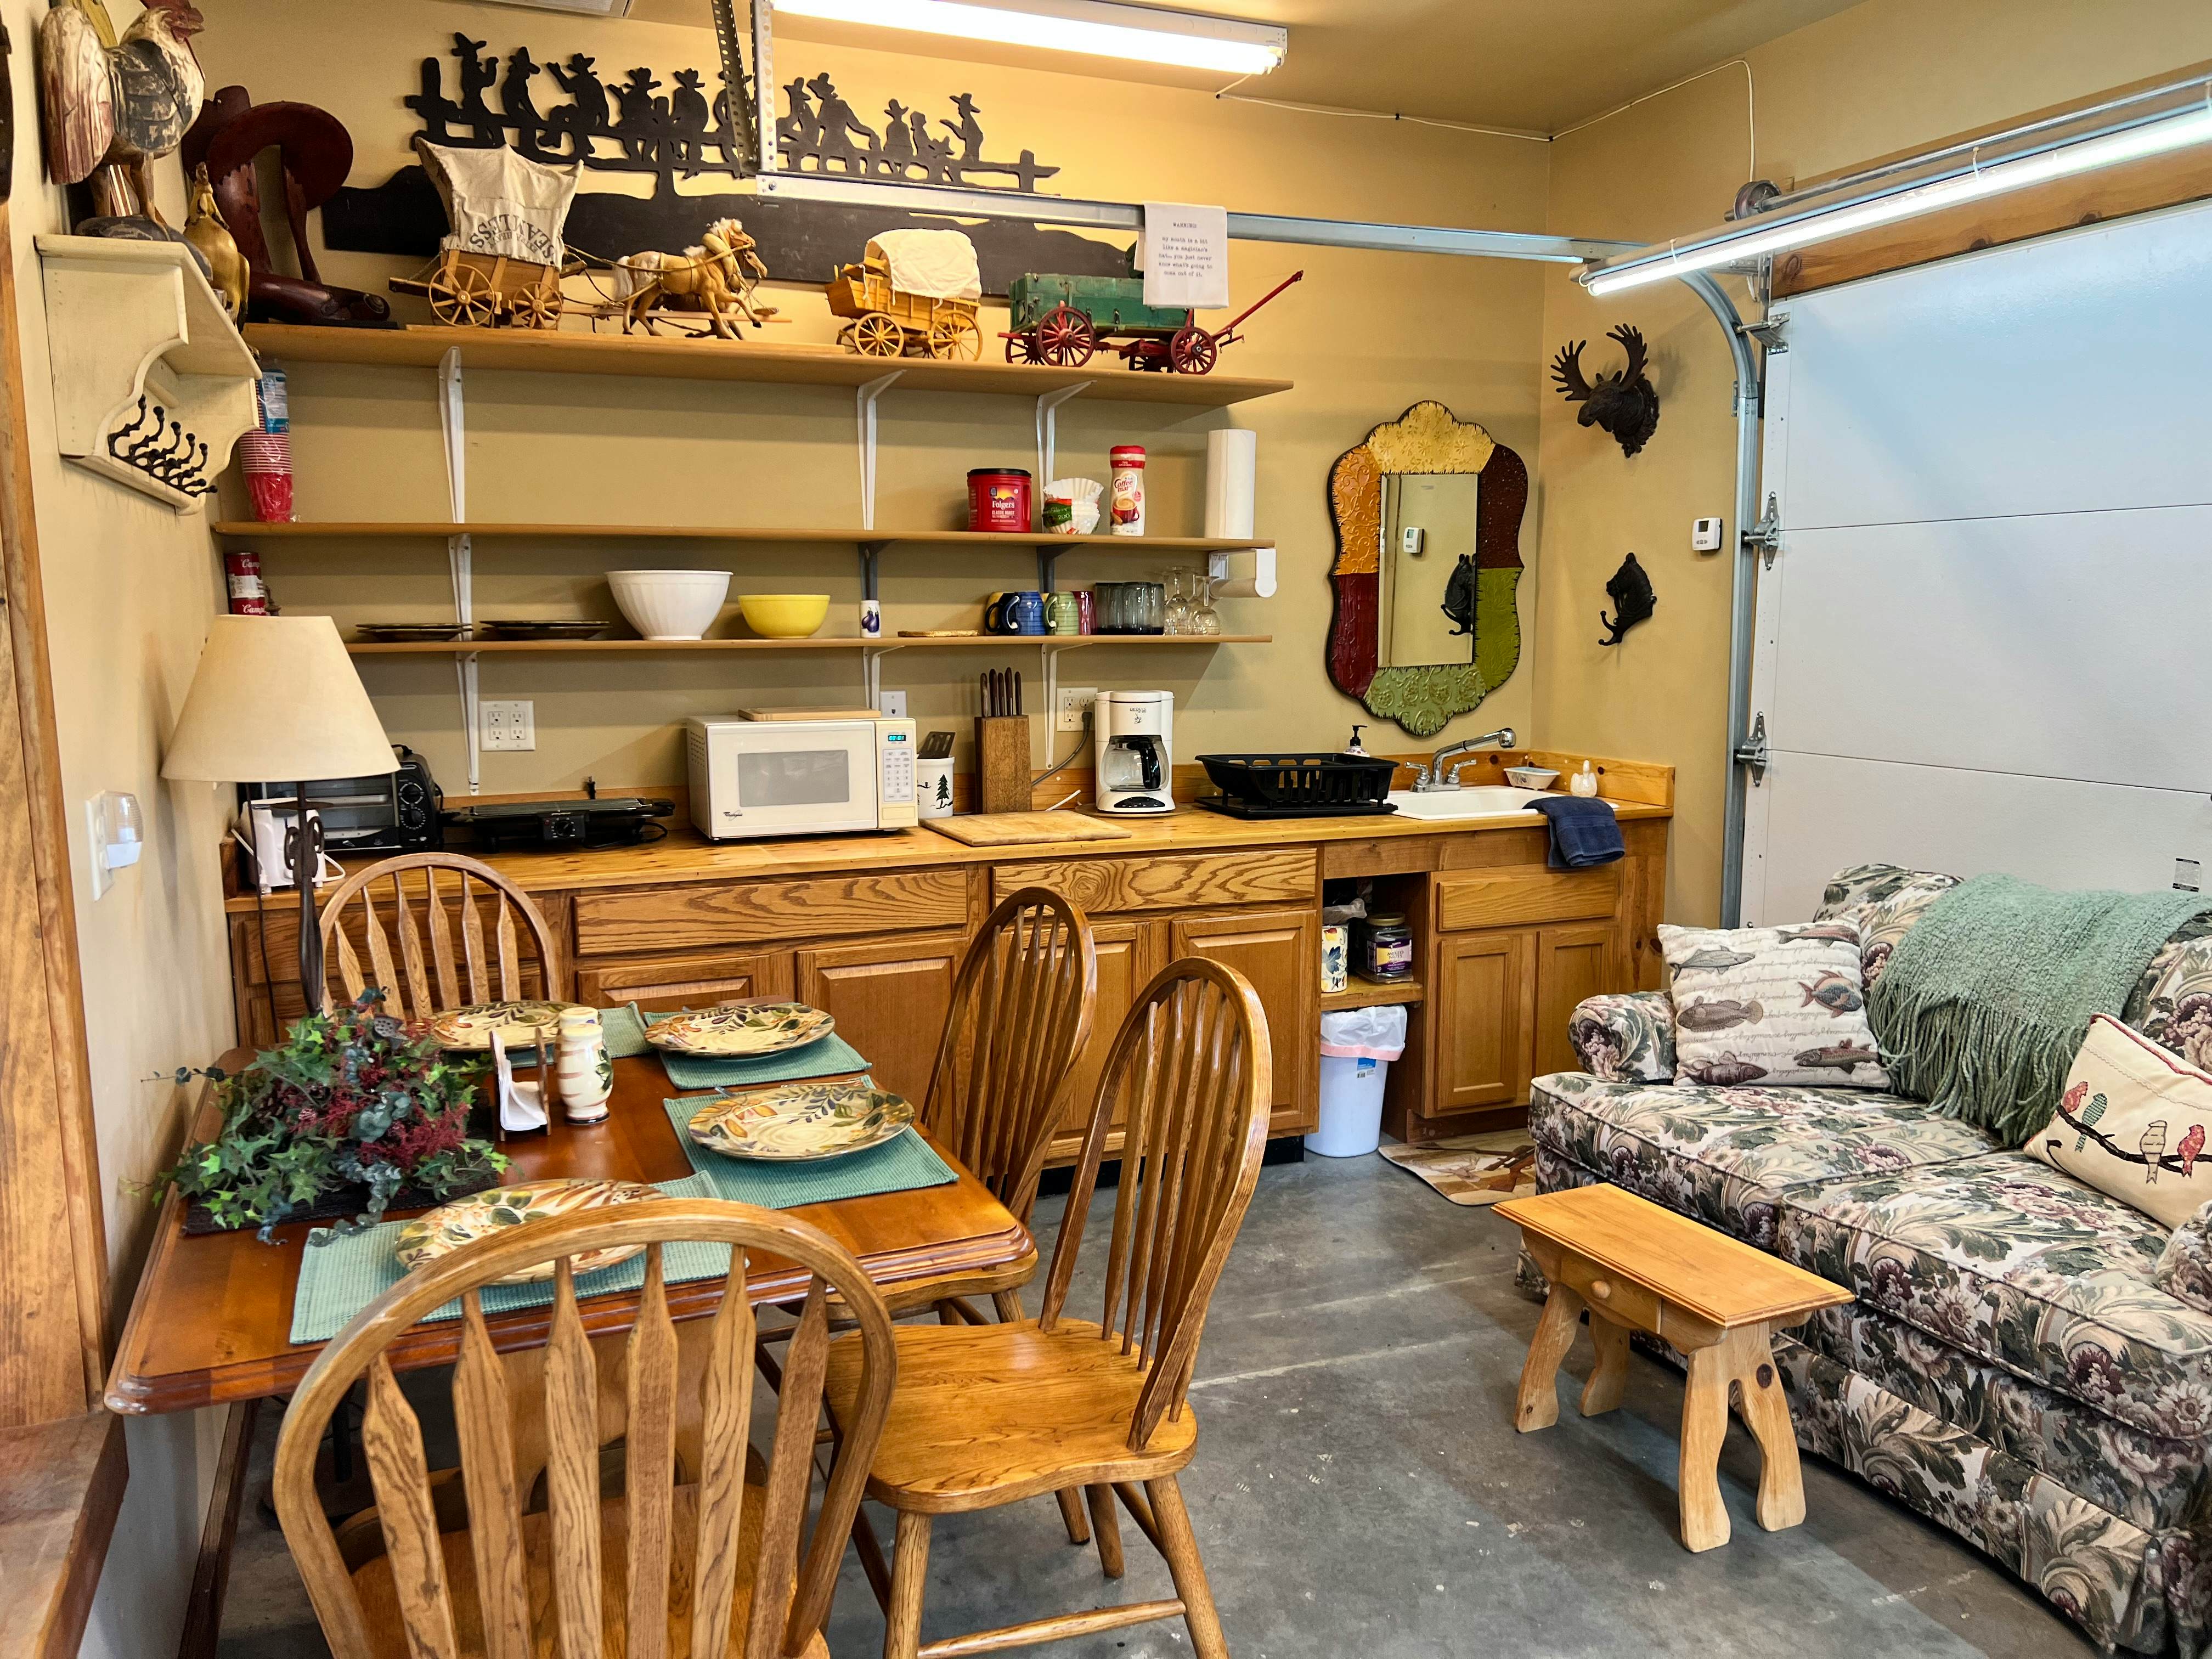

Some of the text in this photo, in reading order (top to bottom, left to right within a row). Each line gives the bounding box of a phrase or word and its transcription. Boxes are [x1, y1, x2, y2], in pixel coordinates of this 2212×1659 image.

[470, 214, 555, 258] SEAMLESS
[1114, 478, 1133, 488] Coffee
[992, 500, 1015, 510] Folgers
